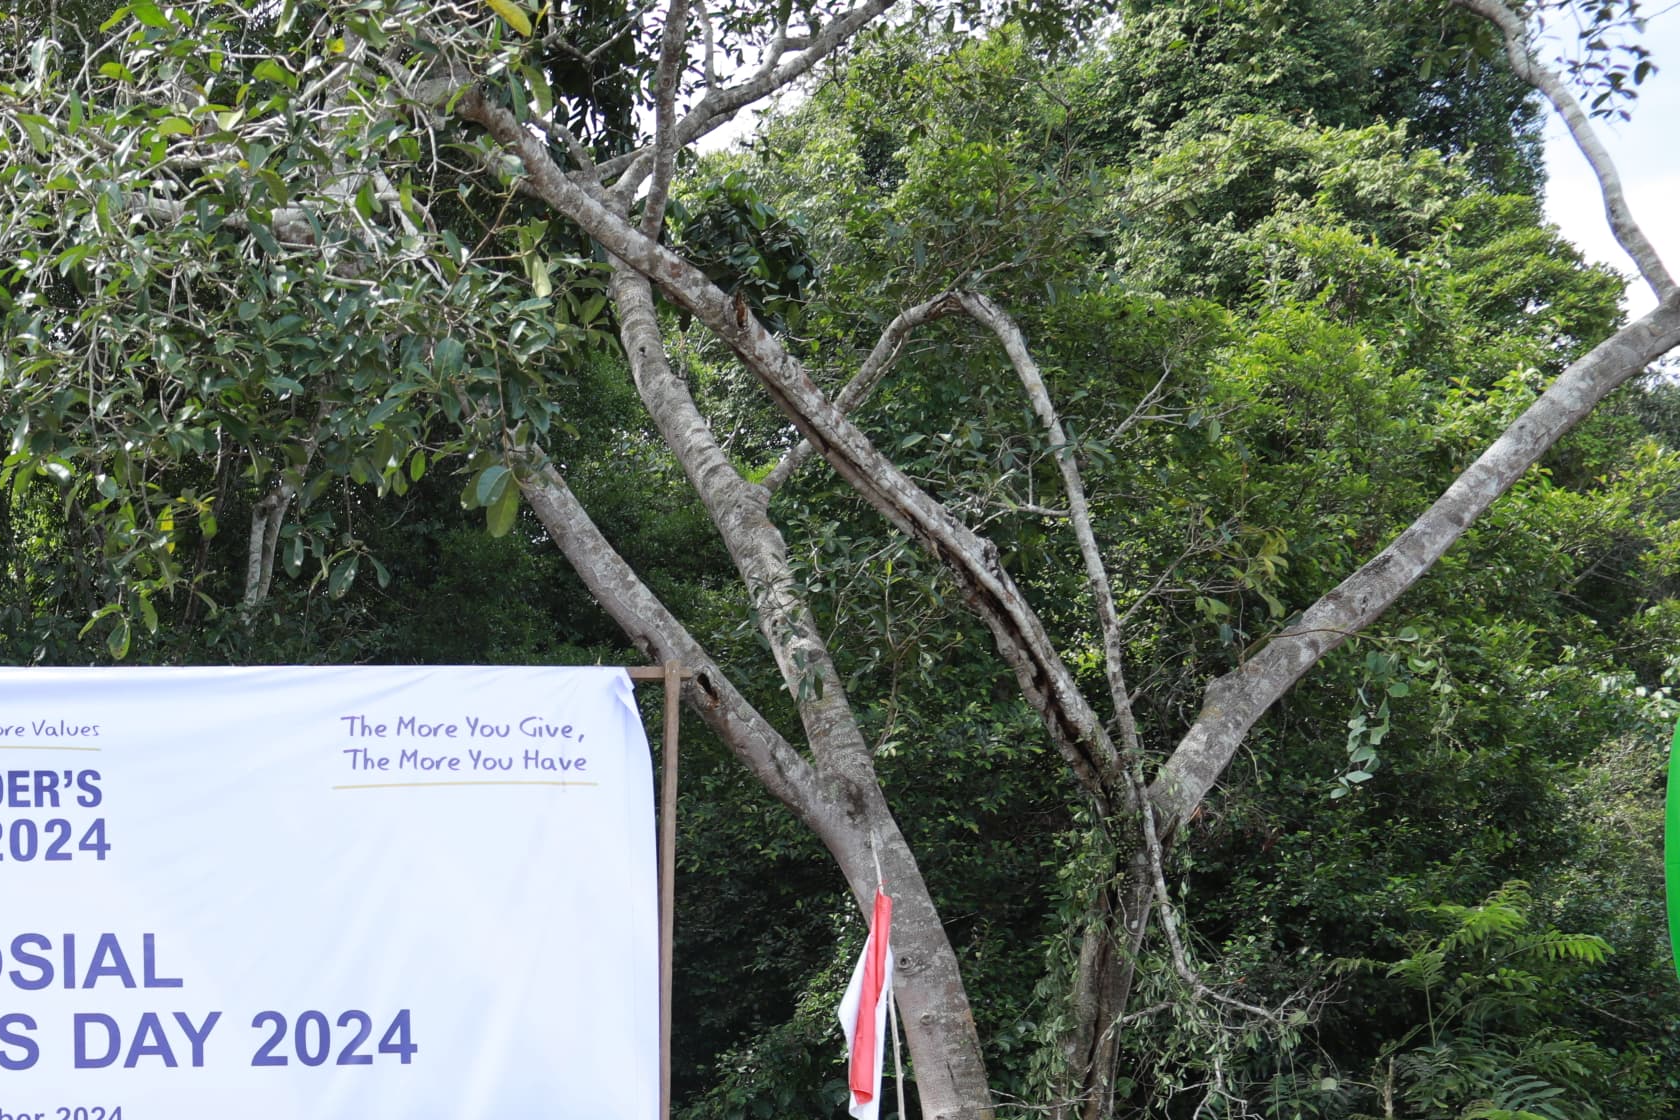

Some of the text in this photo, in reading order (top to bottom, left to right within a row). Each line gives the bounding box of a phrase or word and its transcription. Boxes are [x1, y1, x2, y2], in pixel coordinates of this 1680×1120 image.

[32, 719, 100, 737] Values
[340, 715, 585, 743] The More You Give,
[343, 748, 587, 771] The More You Have
[73, 1010, 223, 1069] DAY
[251, 1008, 419, 1067] 2024
